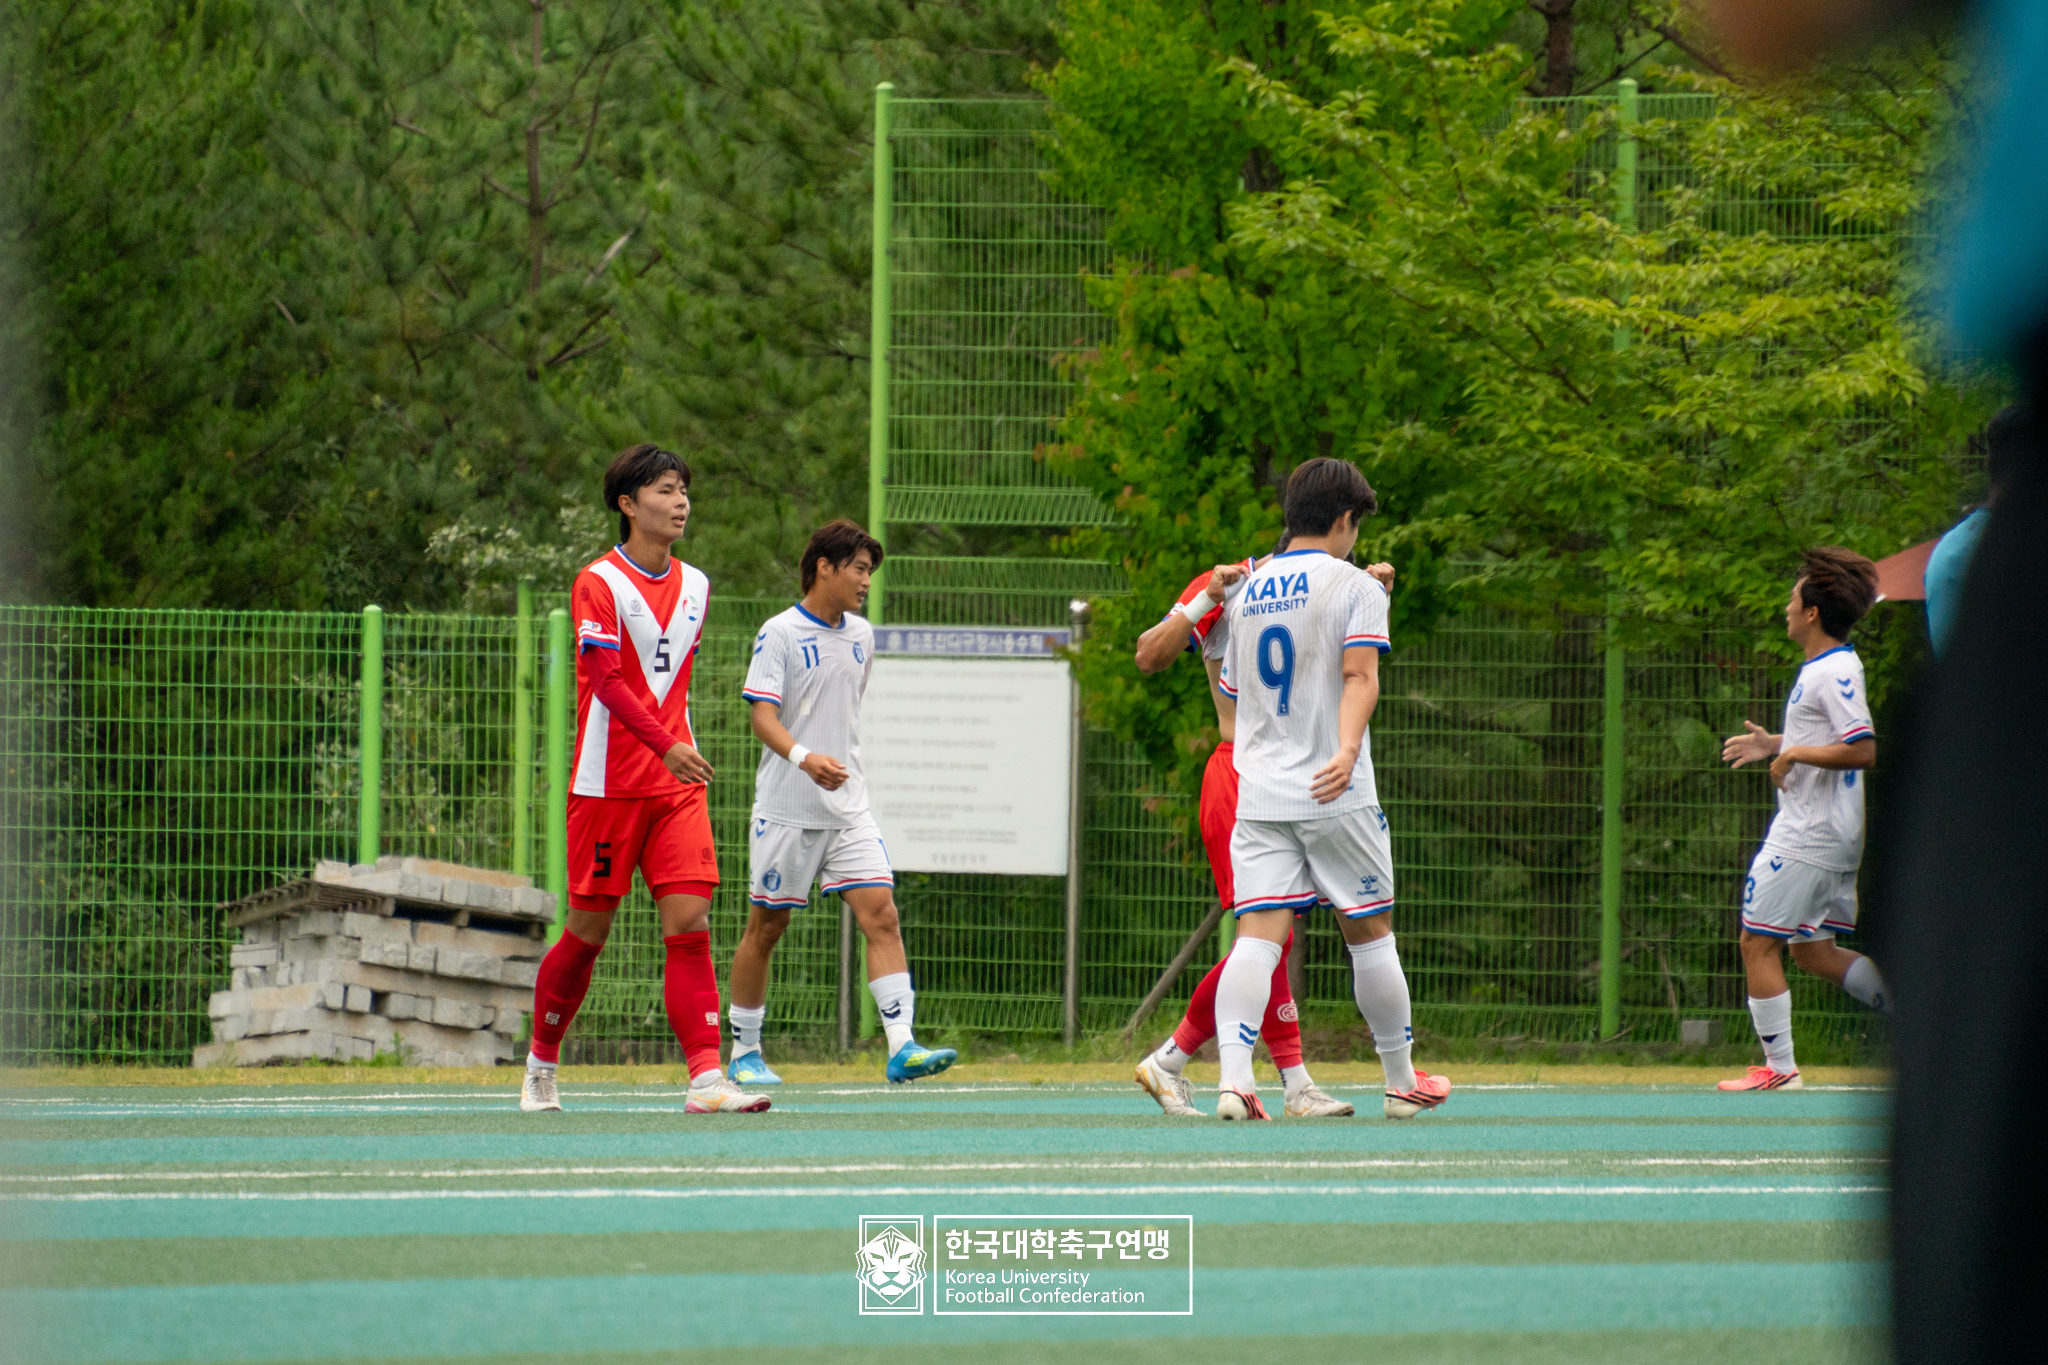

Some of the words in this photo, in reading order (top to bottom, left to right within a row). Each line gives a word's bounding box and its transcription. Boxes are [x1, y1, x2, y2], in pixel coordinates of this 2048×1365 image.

[1244, 572, 1309, 604] KAYA
[1242, 596, 1309, 617] UNIVERSITY
[653, 638, 671, 673] 5
[801, 644, 820, 669] 11
[1256, 623, 1296, 717] 9
[593, 842, 611, 878] 5
